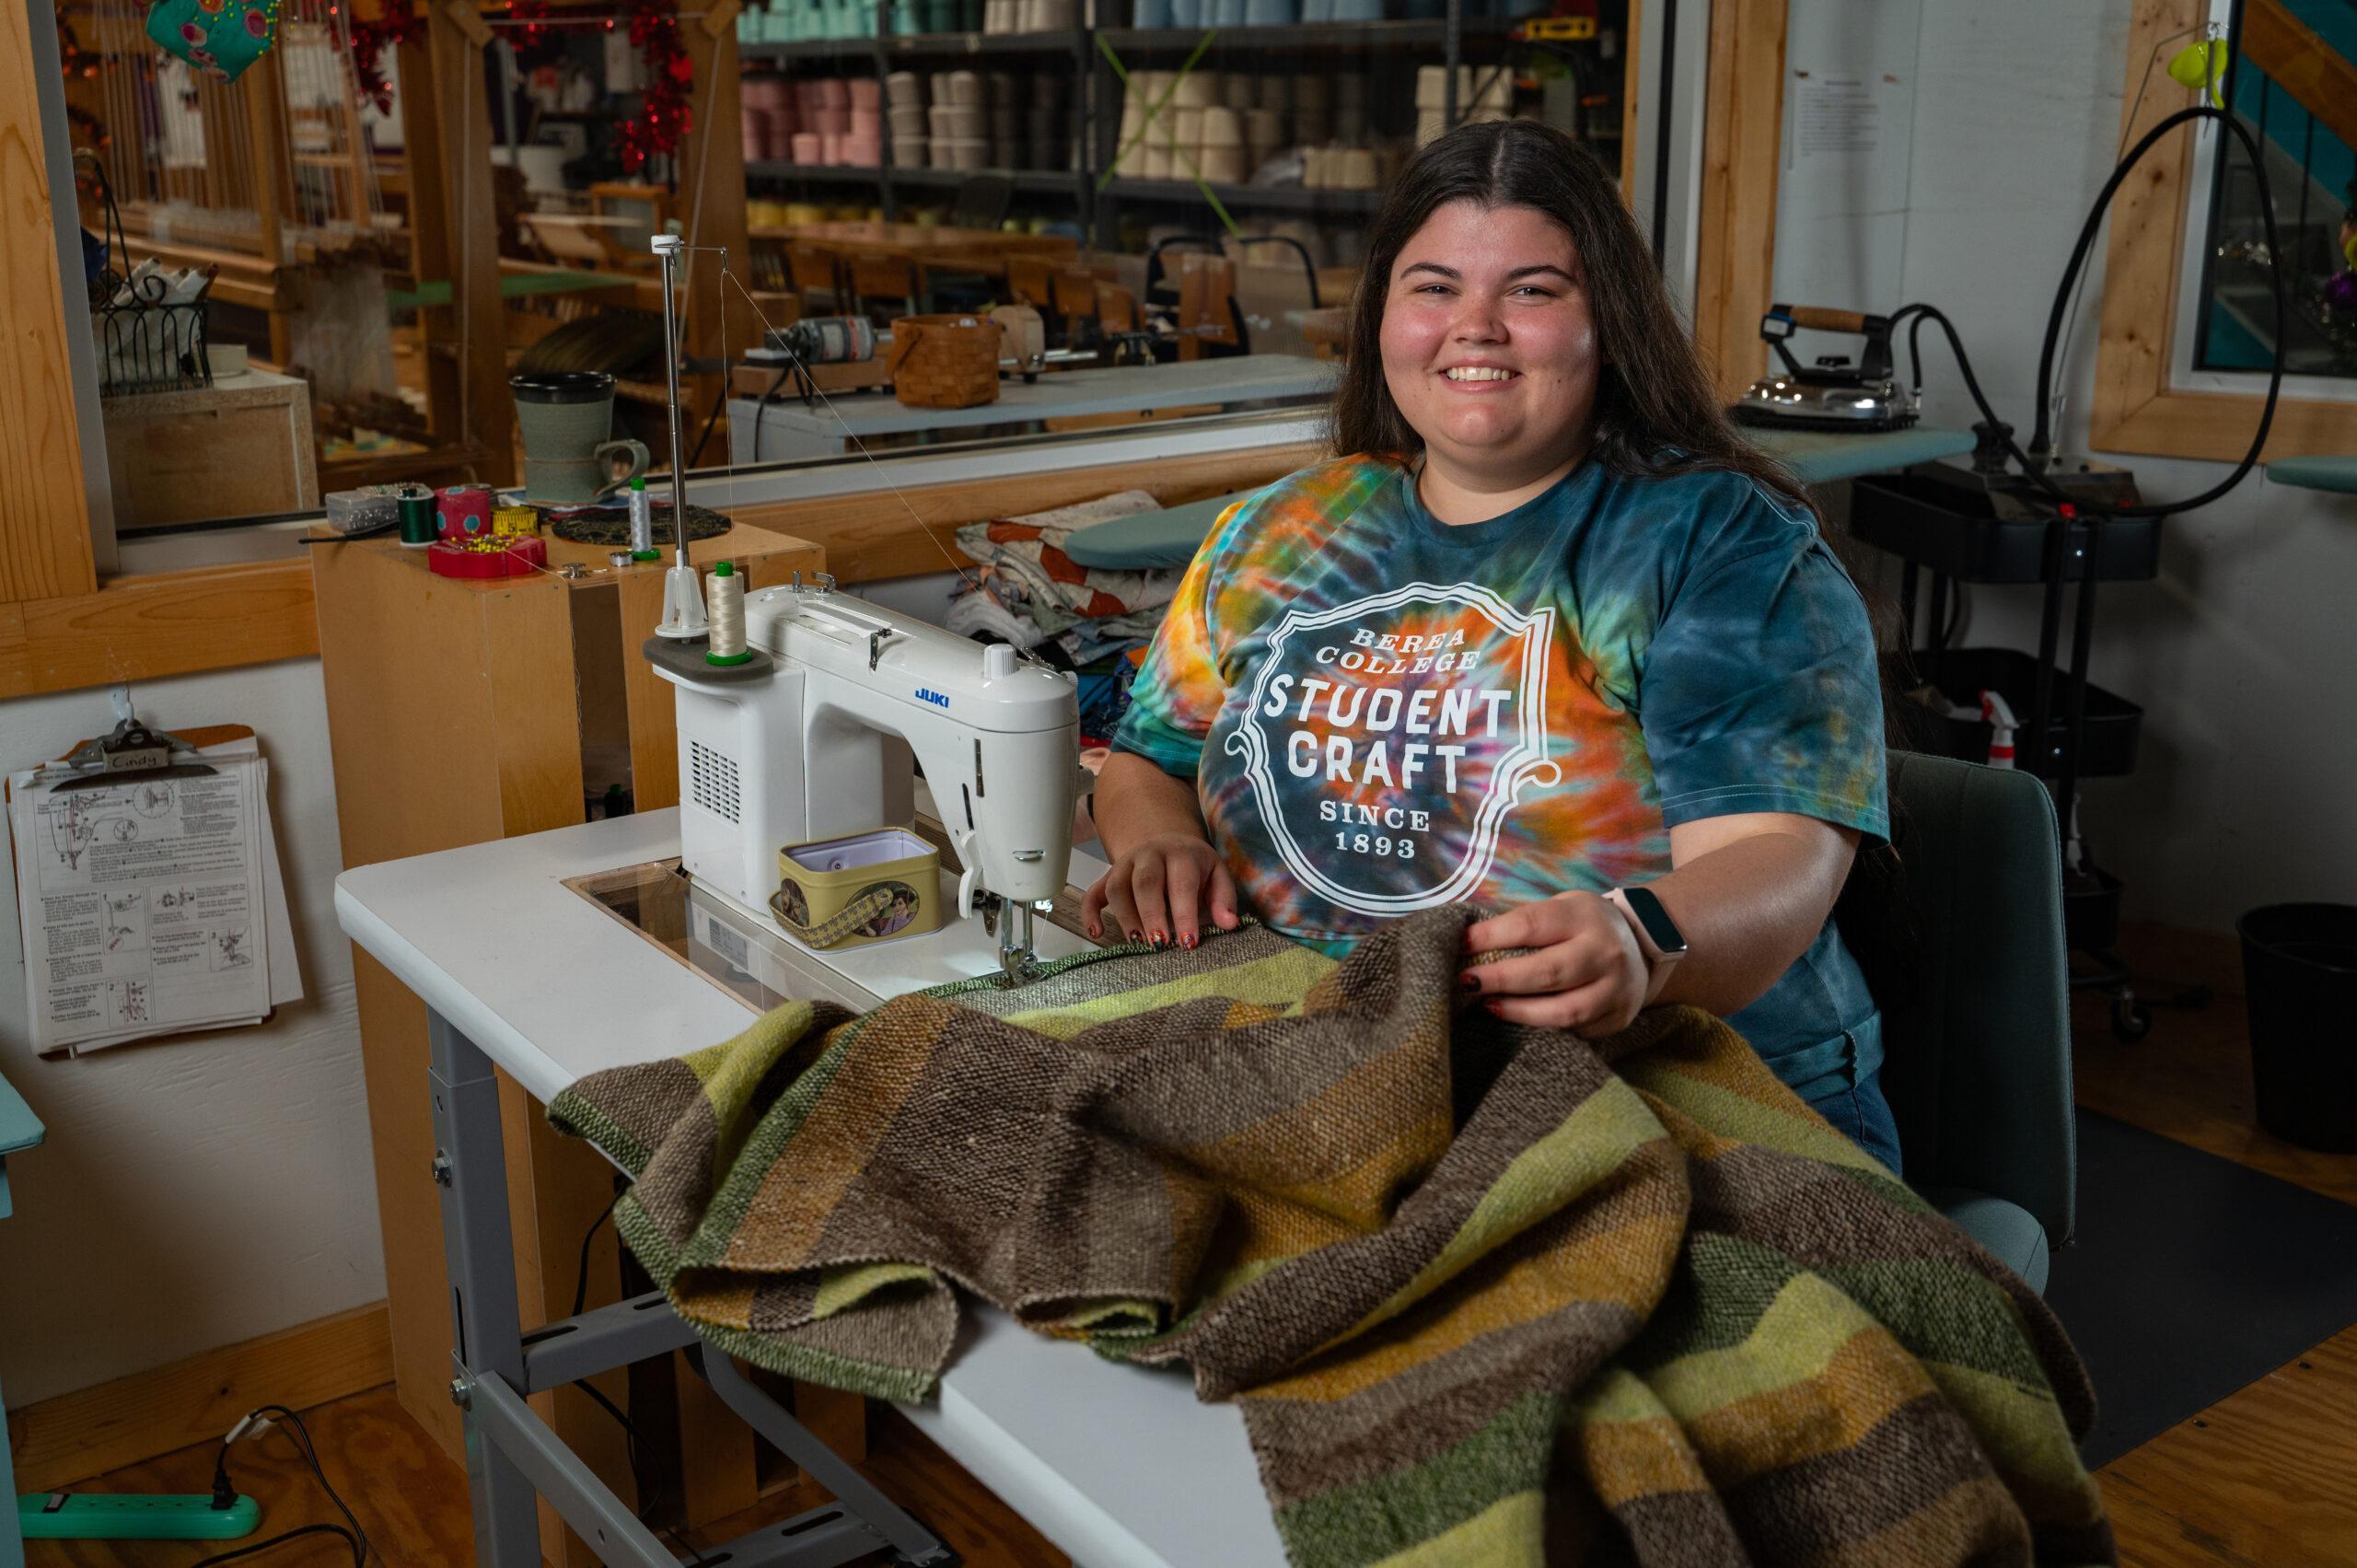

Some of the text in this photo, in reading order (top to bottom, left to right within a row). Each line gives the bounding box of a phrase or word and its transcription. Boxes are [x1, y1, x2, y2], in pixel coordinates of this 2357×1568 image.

[1350, 628, 1465, 653] BEREA
[1316, 646, 1480, 675] COLLEGE
[915, 688, 949, 708] JUKI
[1264, 673, 1512, 738] STUDENT
[112, 755, 157, 769] Cindy
[1287, 730, 1466, 794] CRAFT
[1320, 800, 1430, 832] SINCE
[1335, 831, 1415, 859] 1893
